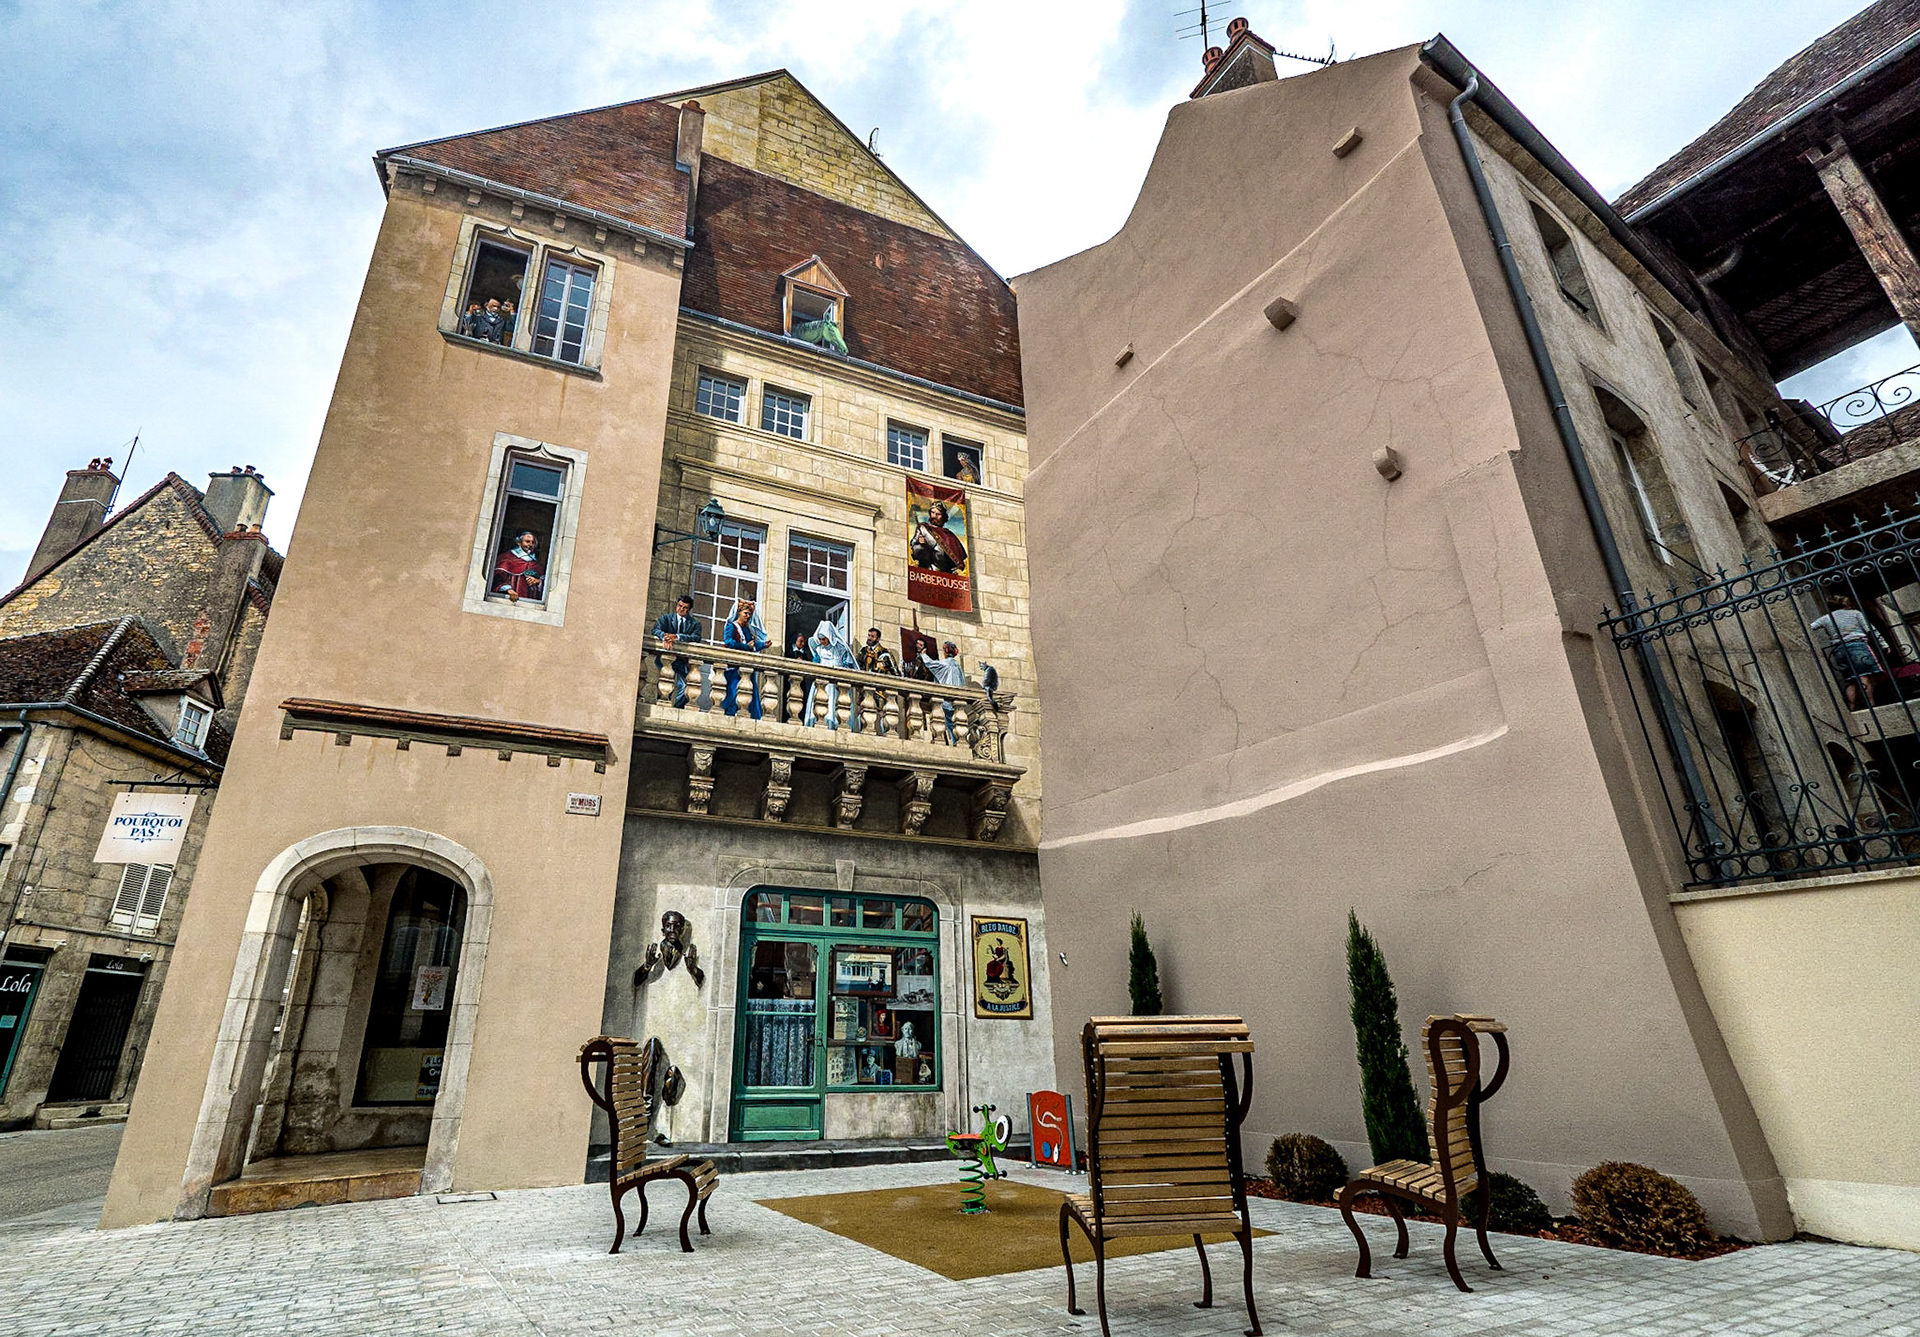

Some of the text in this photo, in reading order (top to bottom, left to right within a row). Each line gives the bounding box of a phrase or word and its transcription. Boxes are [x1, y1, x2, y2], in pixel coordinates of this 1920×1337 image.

[909, 571, 970, 591] BARBEROUSSE
[114, 817, 184, 828] POURQUOI
[981, 923, 996, 933] BLEU
[106, 960, 124, 970] Lola
[0, 973, 31, 993] Lola
